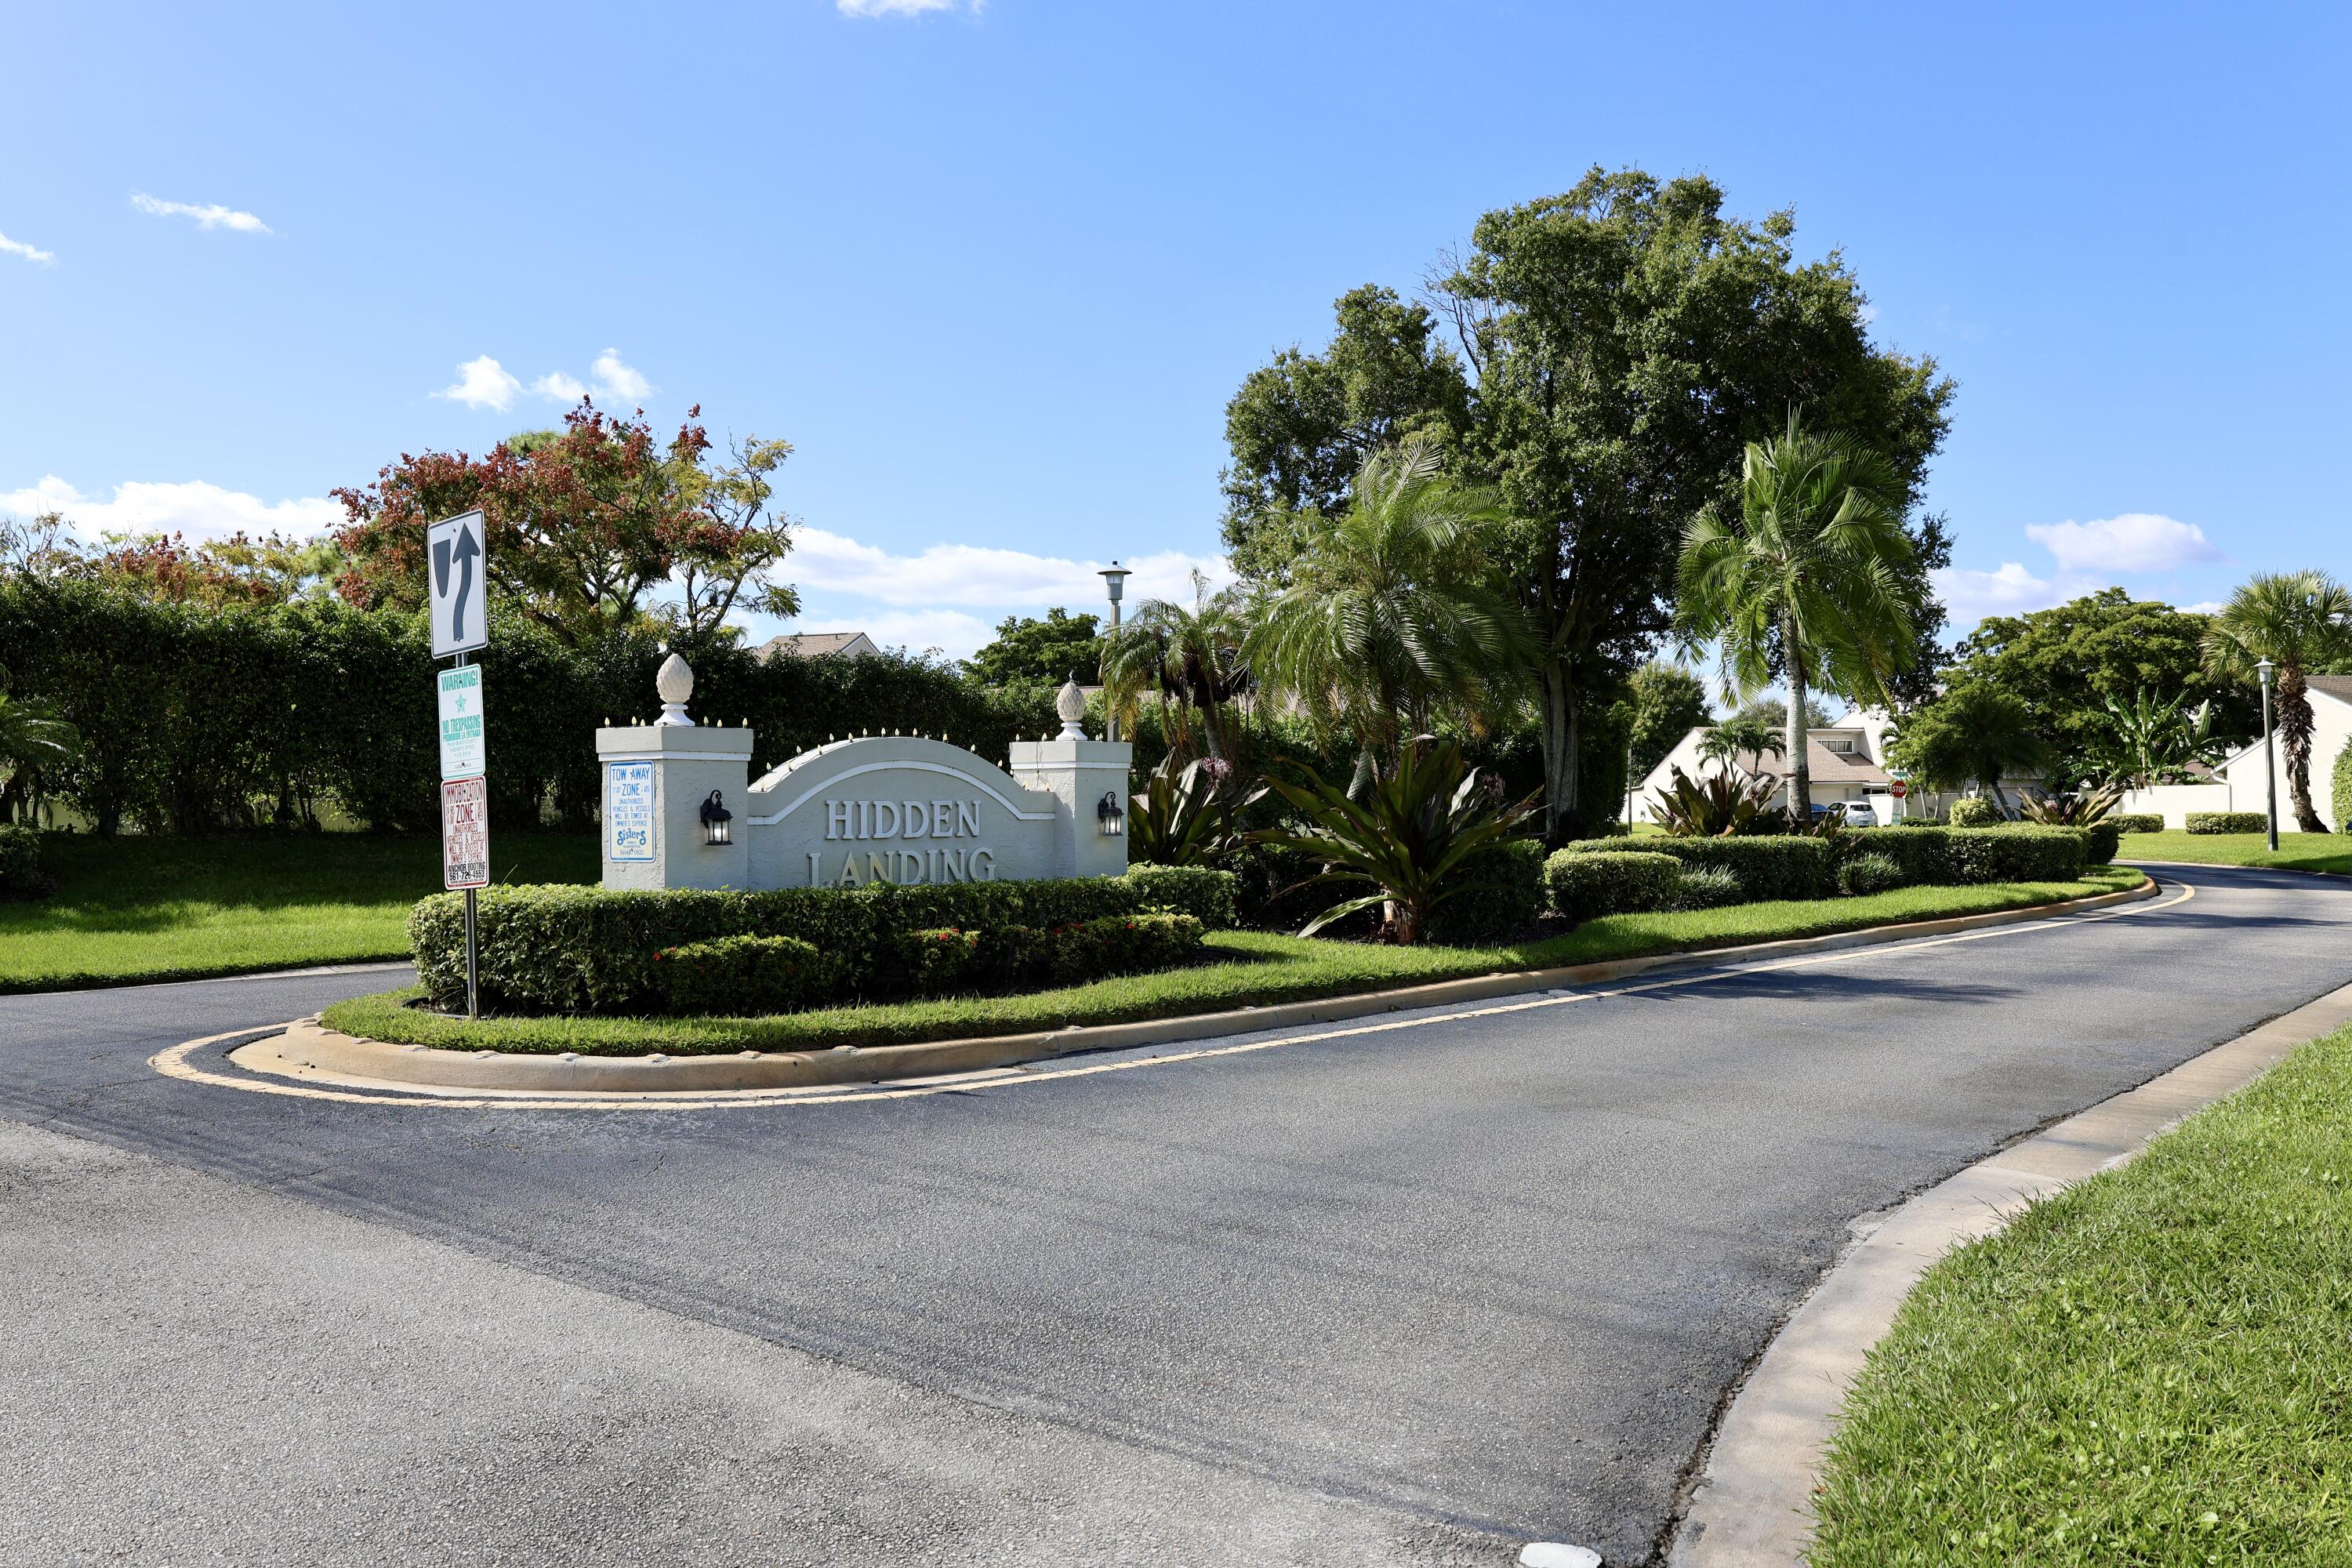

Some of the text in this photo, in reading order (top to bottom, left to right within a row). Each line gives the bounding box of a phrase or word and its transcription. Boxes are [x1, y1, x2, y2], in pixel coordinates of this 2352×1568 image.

[441, 670, 478, 691] WARNING!
[442, 714, 481, 734] NO TRESPASSING
[612, 767, 650, 781] TOW AWAY
[445, 781, 483, 804] IMMOBILIZATION
[622, 783, 640, 796] ZONE
[456, 802, 474, 824] ZONE
[825, 800, 981, 840] HIDDEN
[452, 822, 478, 835] UNAUTHORIZED
[447, 831, 485, 845] VEHICLES & VESSELS
[448, 841, 484, 855] WILL BE BOOTED AT
[468, 852, 483, 862] EXPENSE
[448, 862, 485, 873] ANCHOR BOOTING
[807, 847, 996, 887] LANDING
